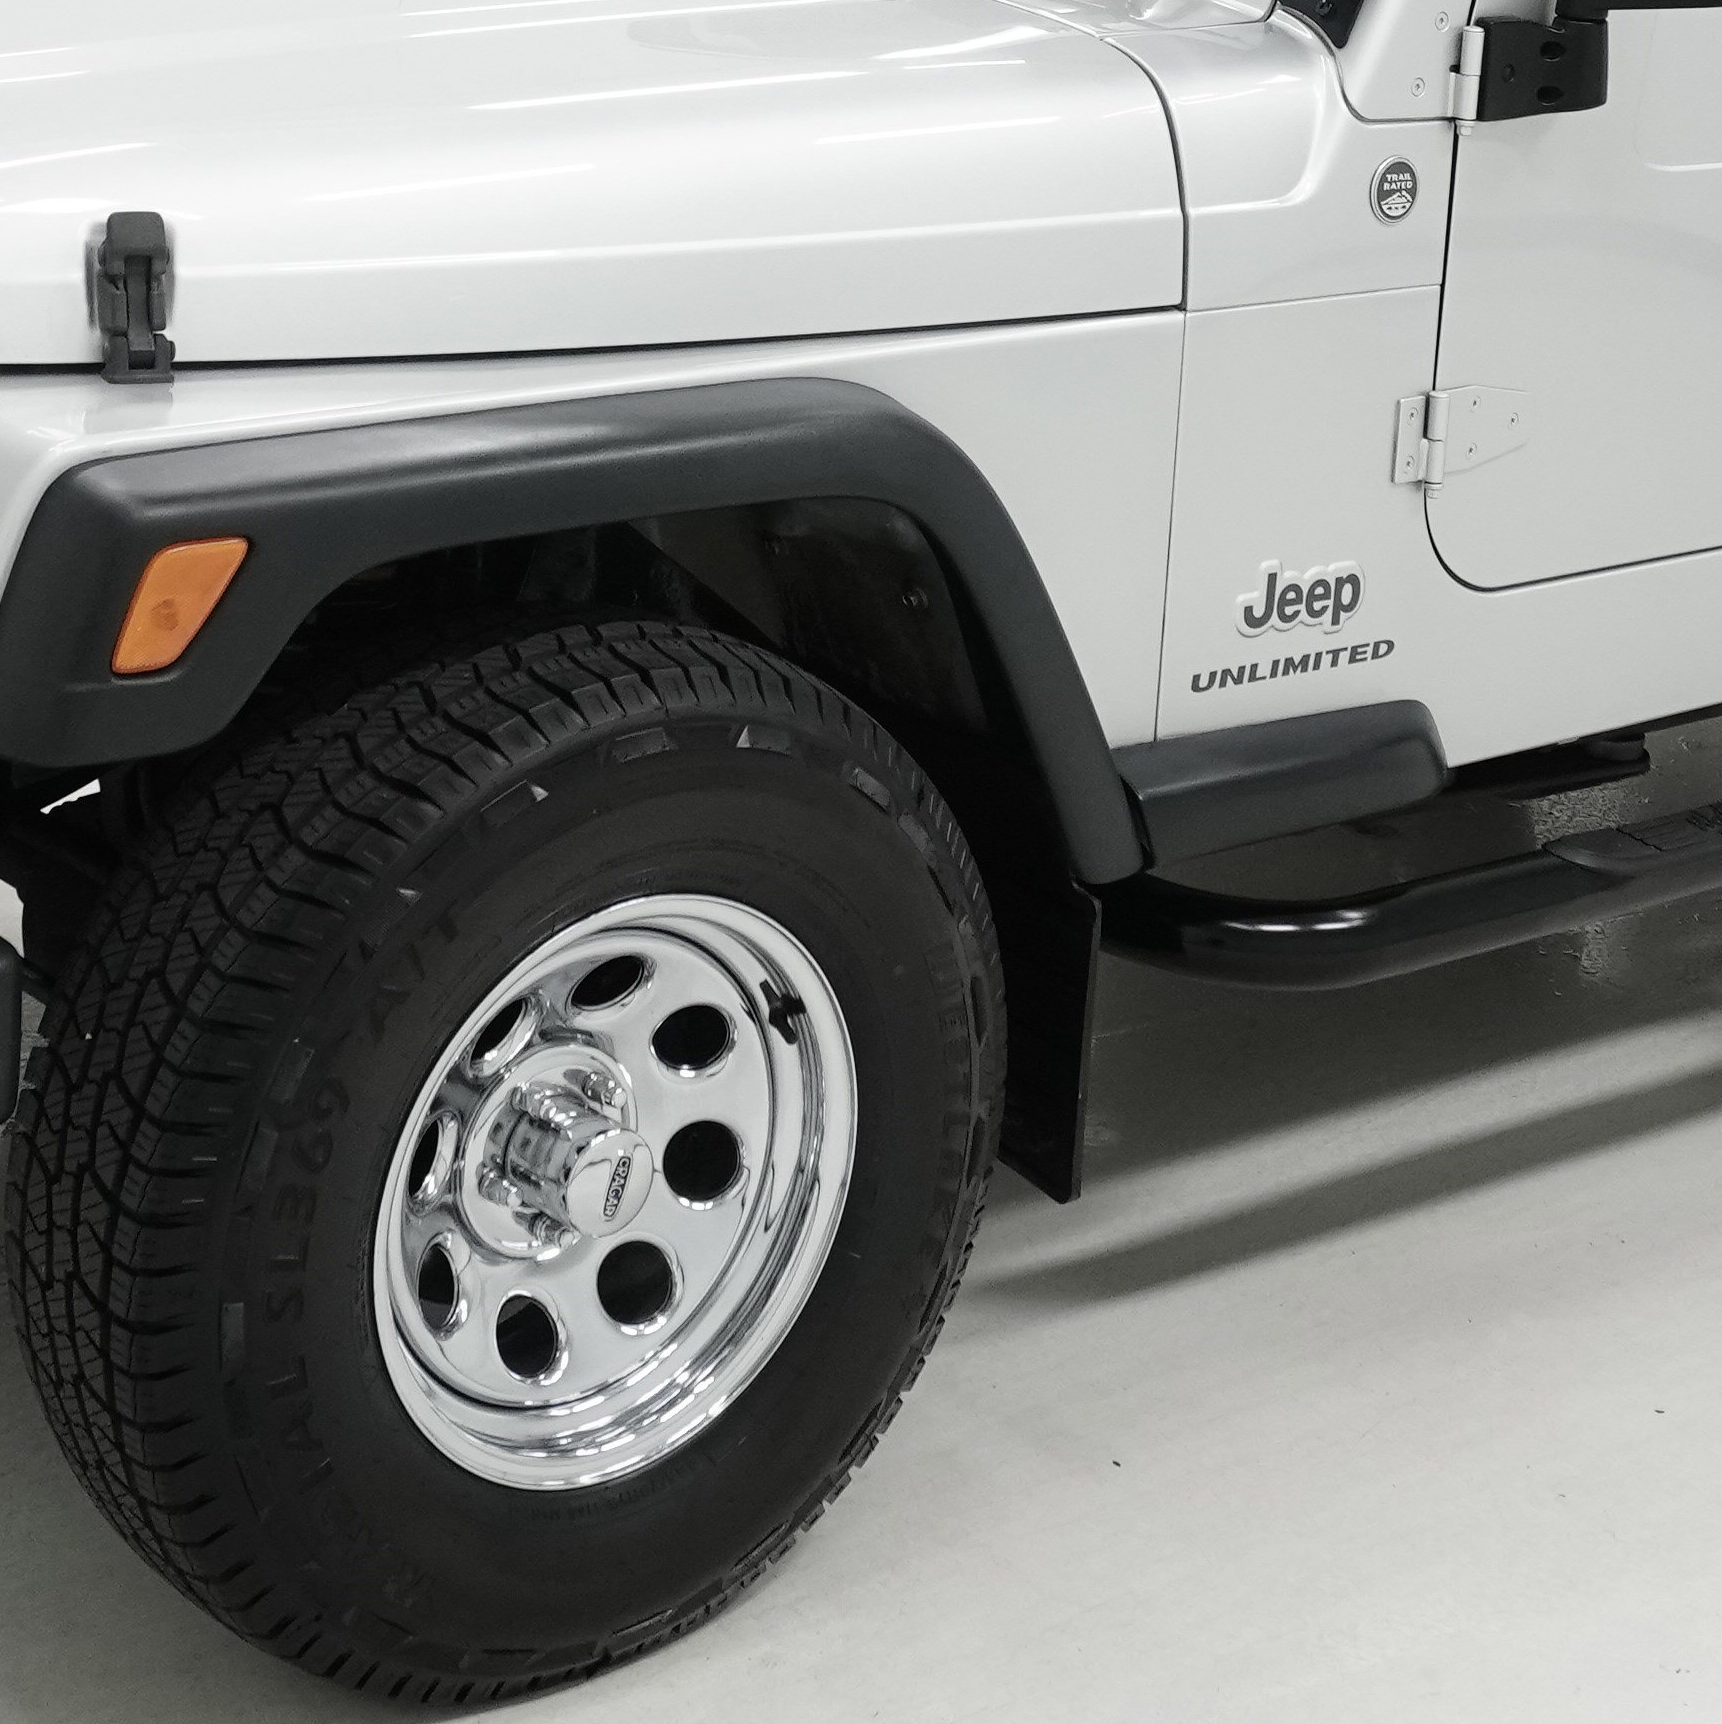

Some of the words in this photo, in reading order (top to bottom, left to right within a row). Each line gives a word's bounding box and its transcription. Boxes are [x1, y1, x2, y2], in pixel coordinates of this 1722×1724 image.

[1384, 181, 1413, 190] RATED
[1386, 173, 1412, 181] TRAIL
[1243, 572, 1361, 629] Jeep
[1191, 639, 1395, 693] UNLIMITED
[605, 1157, 630, 1216] CRAGAR
